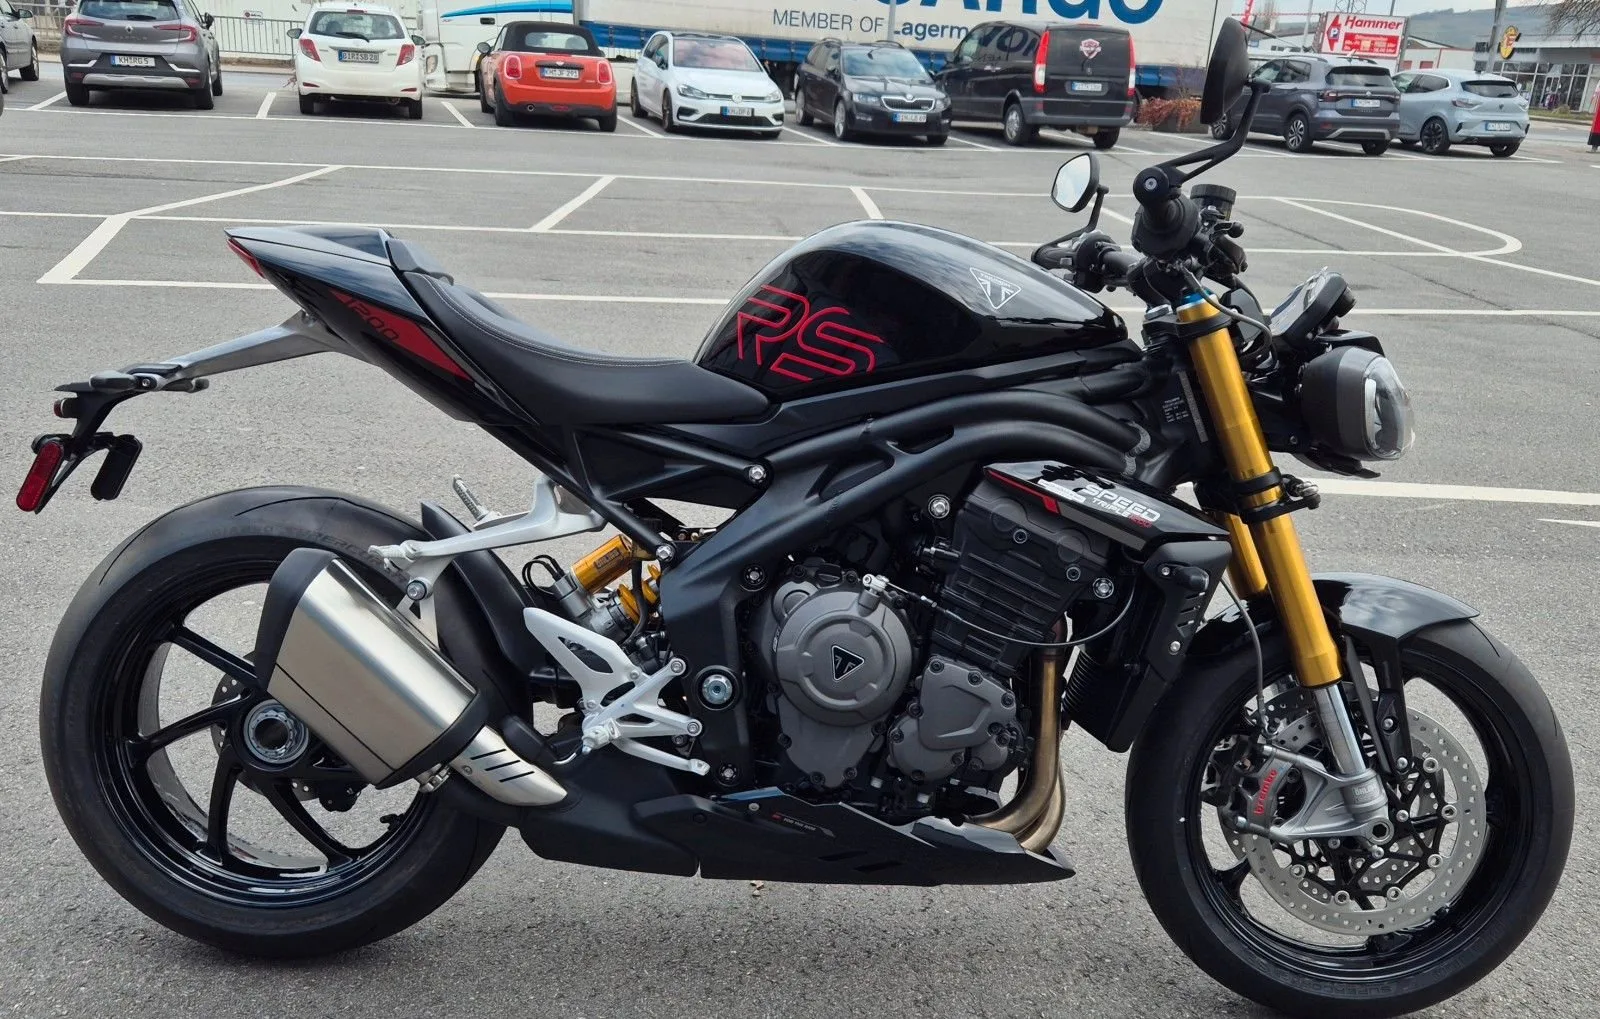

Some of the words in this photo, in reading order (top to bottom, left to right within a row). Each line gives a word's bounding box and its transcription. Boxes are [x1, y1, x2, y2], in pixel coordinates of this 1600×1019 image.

[773, 9, 853, 31] MEMBER
[860, 16, 884, 33] OF
[1344, 15, 1403, 30] Hammer
[737, 284, 884, 383] RS
[1081, 484, 1161, 522] SPEED
[1092, 497, 1134, 518] TRIPLE
[1253, 769, 1278, 816] brembo
